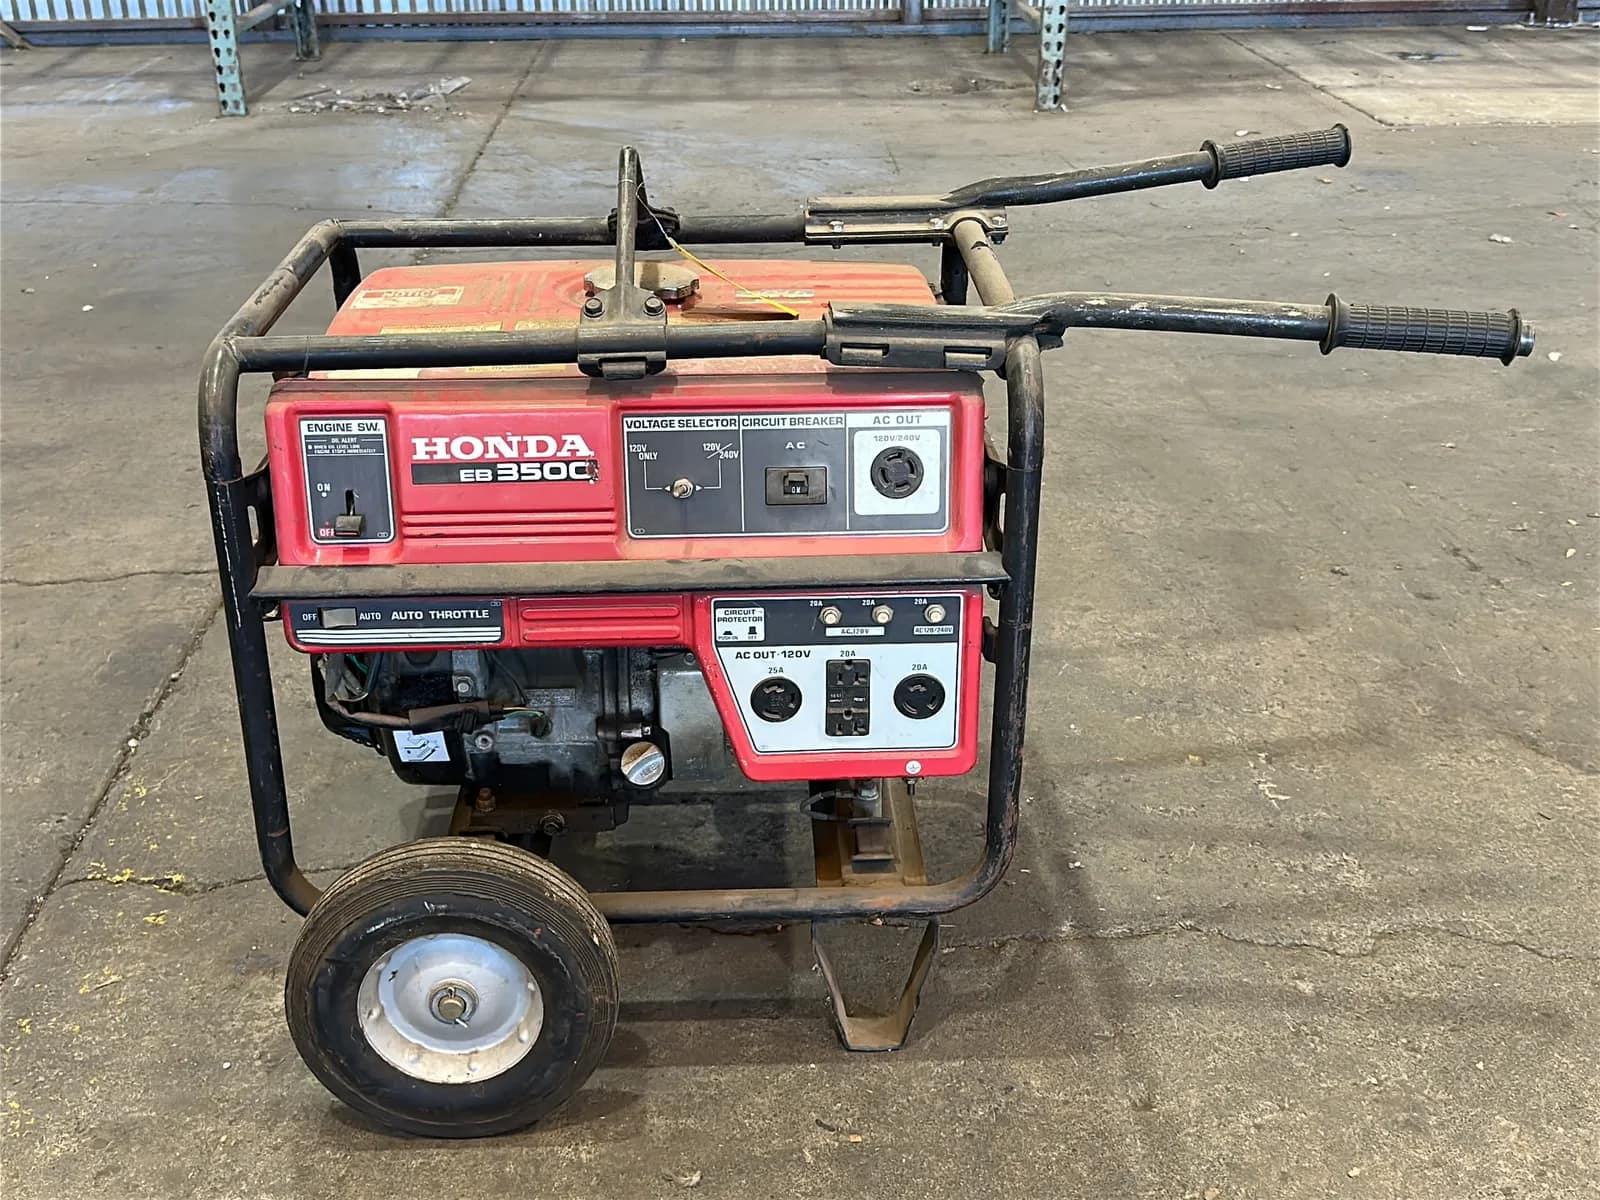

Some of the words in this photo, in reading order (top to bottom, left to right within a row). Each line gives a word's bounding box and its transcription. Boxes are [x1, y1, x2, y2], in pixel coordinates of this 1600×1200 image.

[625, 419, 676, 429] VOLTAGE
[677, 418, 737, 428] SELECTOR
[741, 418, 787, 427] CIRCUIT
[789, 416, 844, 426] BREAKER
[872, 415, 891, 425] AC
[895, 415, 922, 424] OUT
[307, 422, 353, 433] ENGINE
[357, 422, 381, 432] SW.
[873, 434, 921, 442] 120V/240V
[411, 434, 595, 460] HONDA
[629, 444, 647, 453] 120V
[785, 441, 806, 449] AC
[638, 452, 658, 460] ONLY
[317, 483, 331, 492] ON
[302, 613, 317, 622] OFF
[359, 612, 381, 621] AUTO
[391, 611, 424, 620] AUTO
[429, 609, 490, 619] THROTTLE
[735, 651, 751, 660] AC
[768, 666, 784, 674] 25A
[911, 663, 928, 671] 20A
